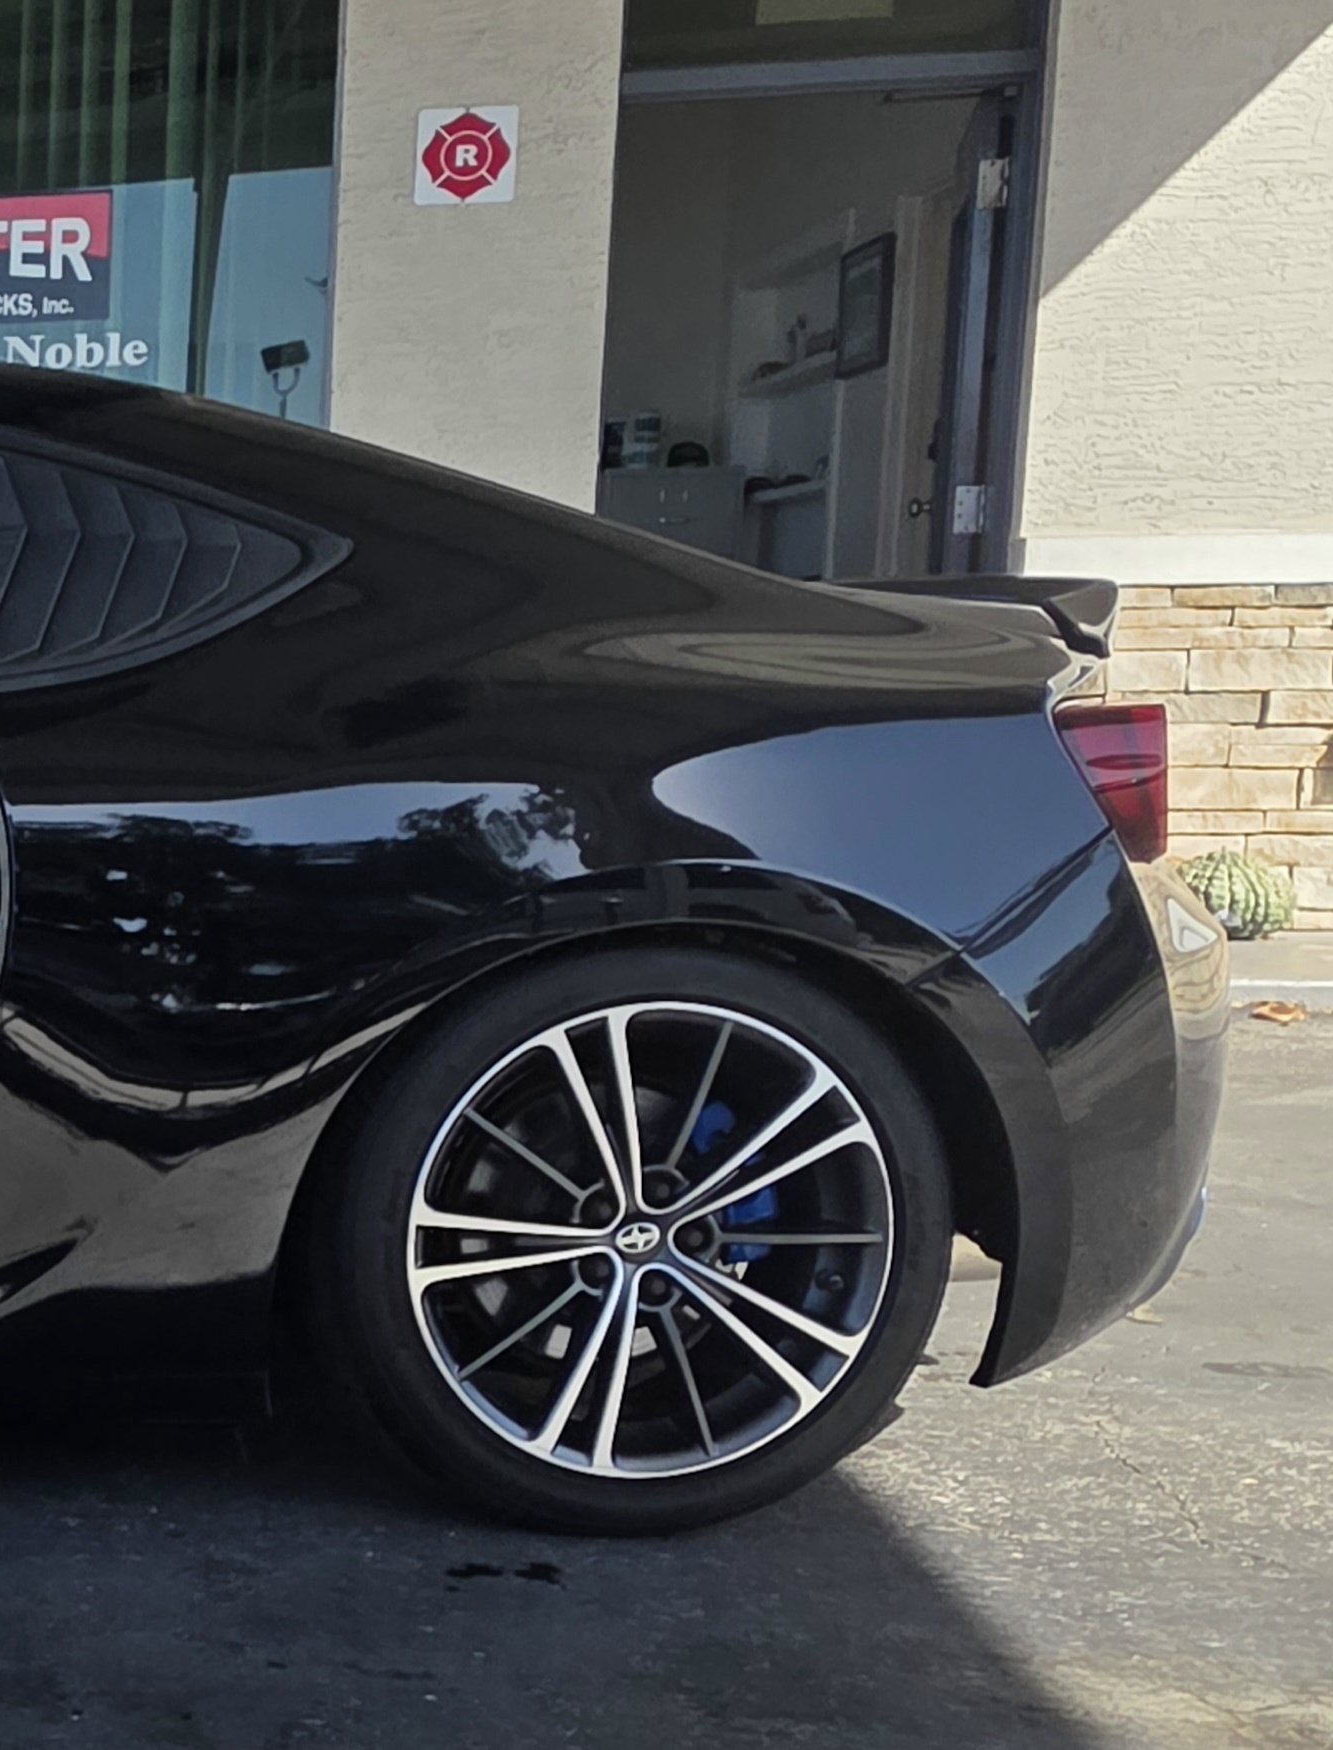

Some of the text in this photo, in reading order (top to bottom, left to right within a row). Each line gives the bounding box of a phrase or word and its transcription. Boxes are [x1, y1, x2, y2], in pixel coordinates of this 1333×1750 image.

[455, 144, 478, 168] R
[42, 297, 74, 315] Inc.
[3, 332, 148, 369] Noble
